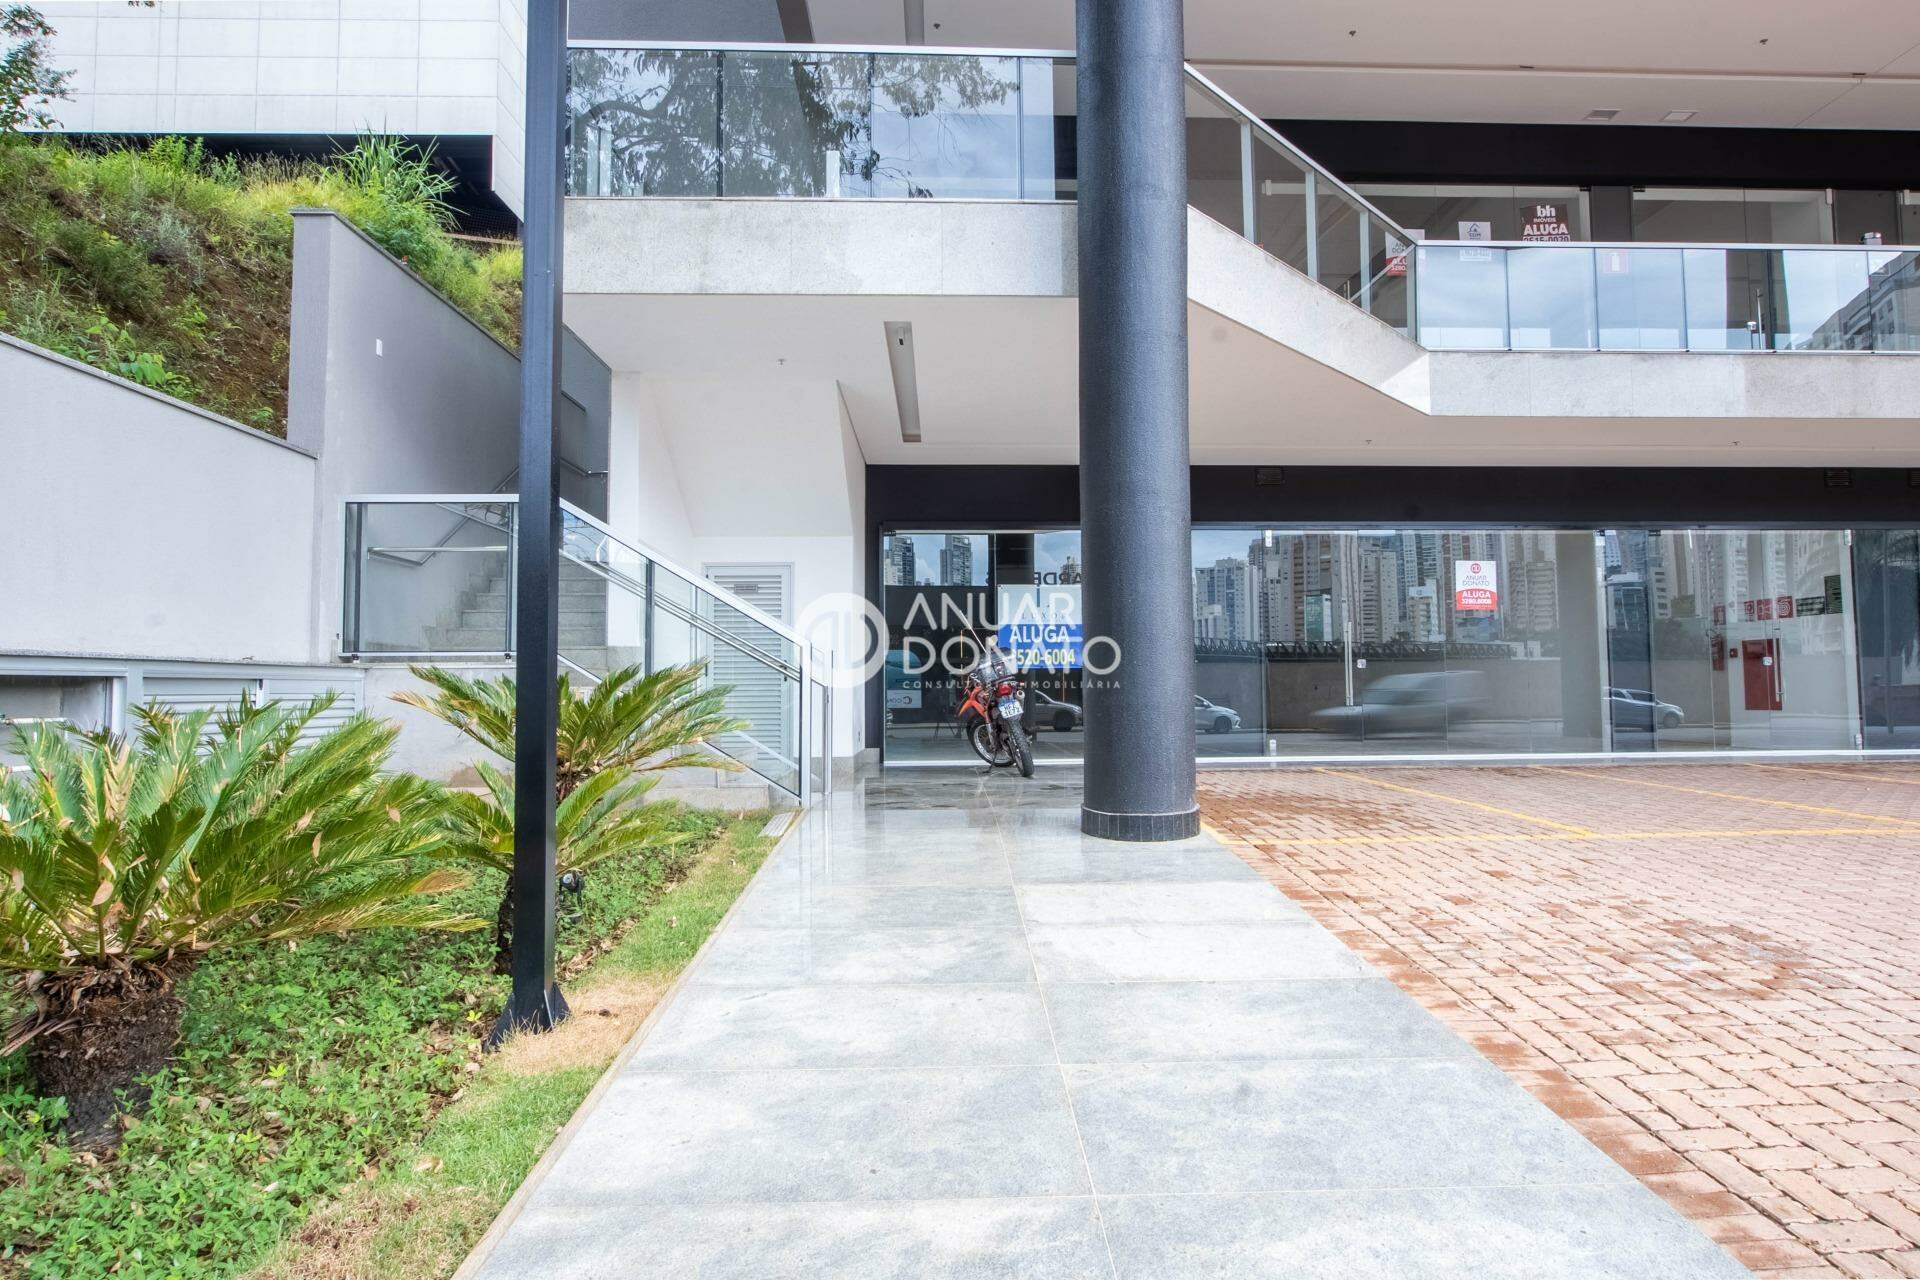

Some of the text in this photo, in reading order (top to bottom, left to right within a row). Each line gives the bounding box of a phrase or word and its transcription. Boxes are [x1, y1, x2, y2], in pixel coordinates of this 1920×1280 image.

[1536, 205, 1556, 217] bh
[1523, 223, 1569, 236] ALUGA
[1462, 590, 1491, 598] ALUGA
[1009, 625, 1070, 643] ALUGA
[1012, 649, 1076, 665] 520-6004
